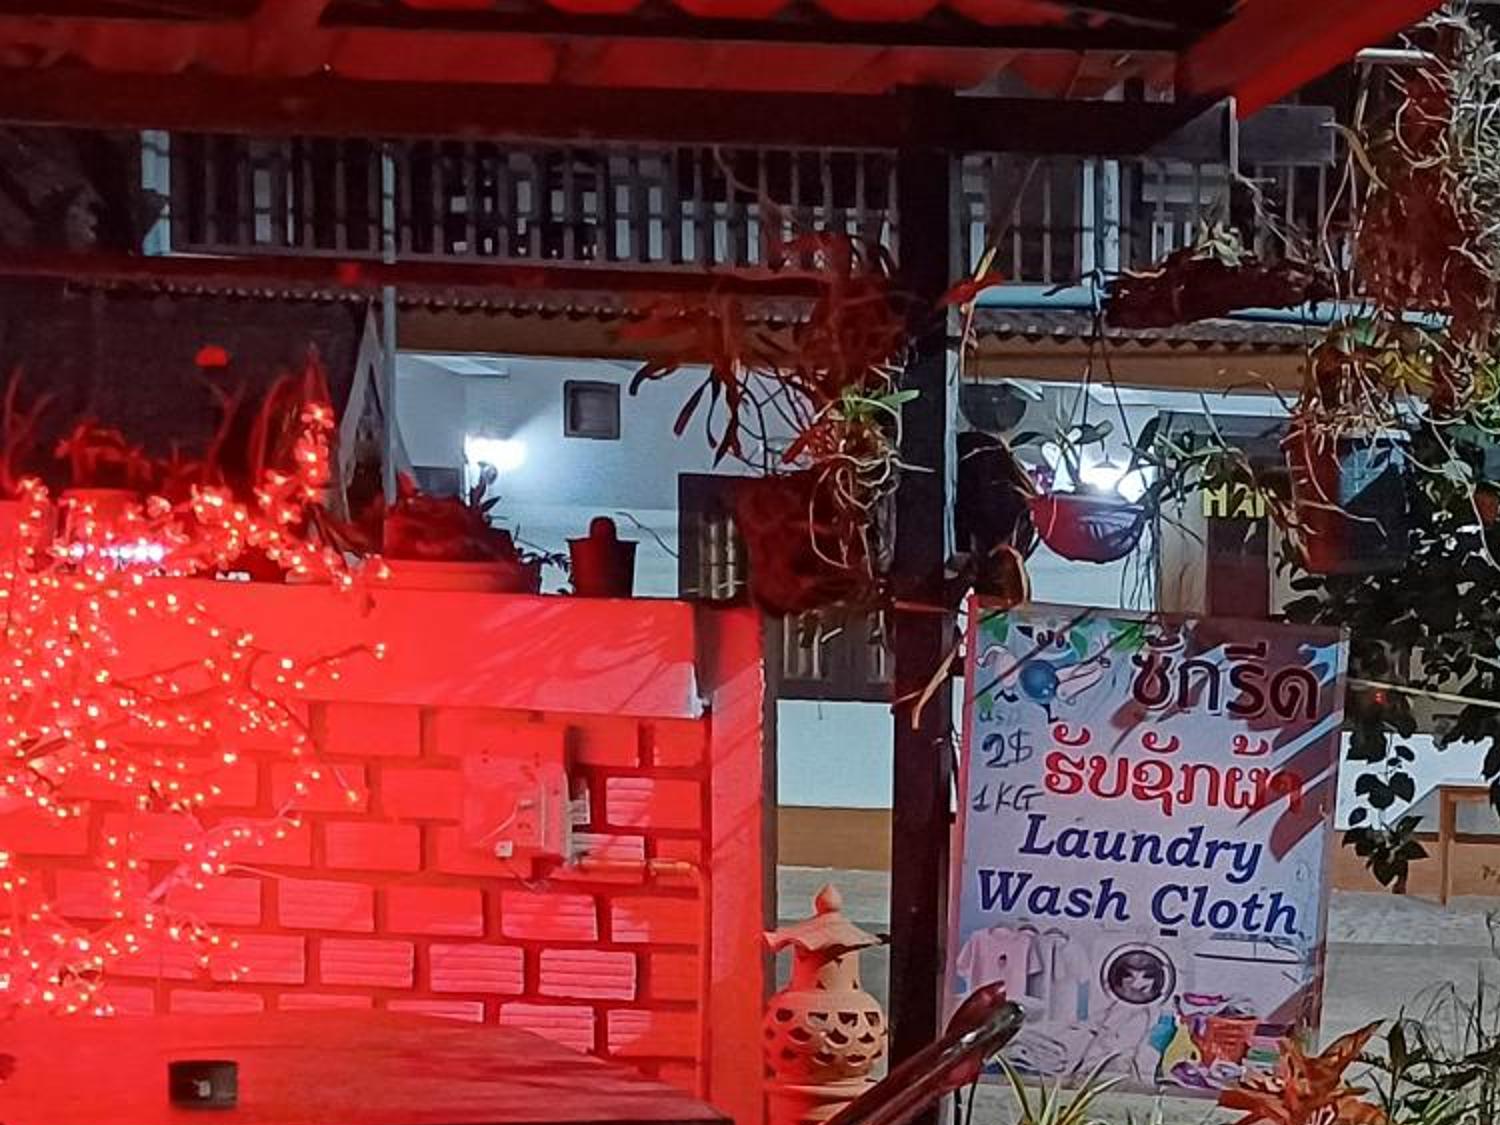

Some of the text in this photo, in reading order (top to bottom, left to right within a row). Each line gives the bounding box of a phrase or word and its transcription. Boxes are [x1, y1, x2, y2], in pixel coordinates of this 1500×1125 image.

[1019, 814, 1263, 883] Laundry
[978, 870, 1298, 935] Wash Cloth
